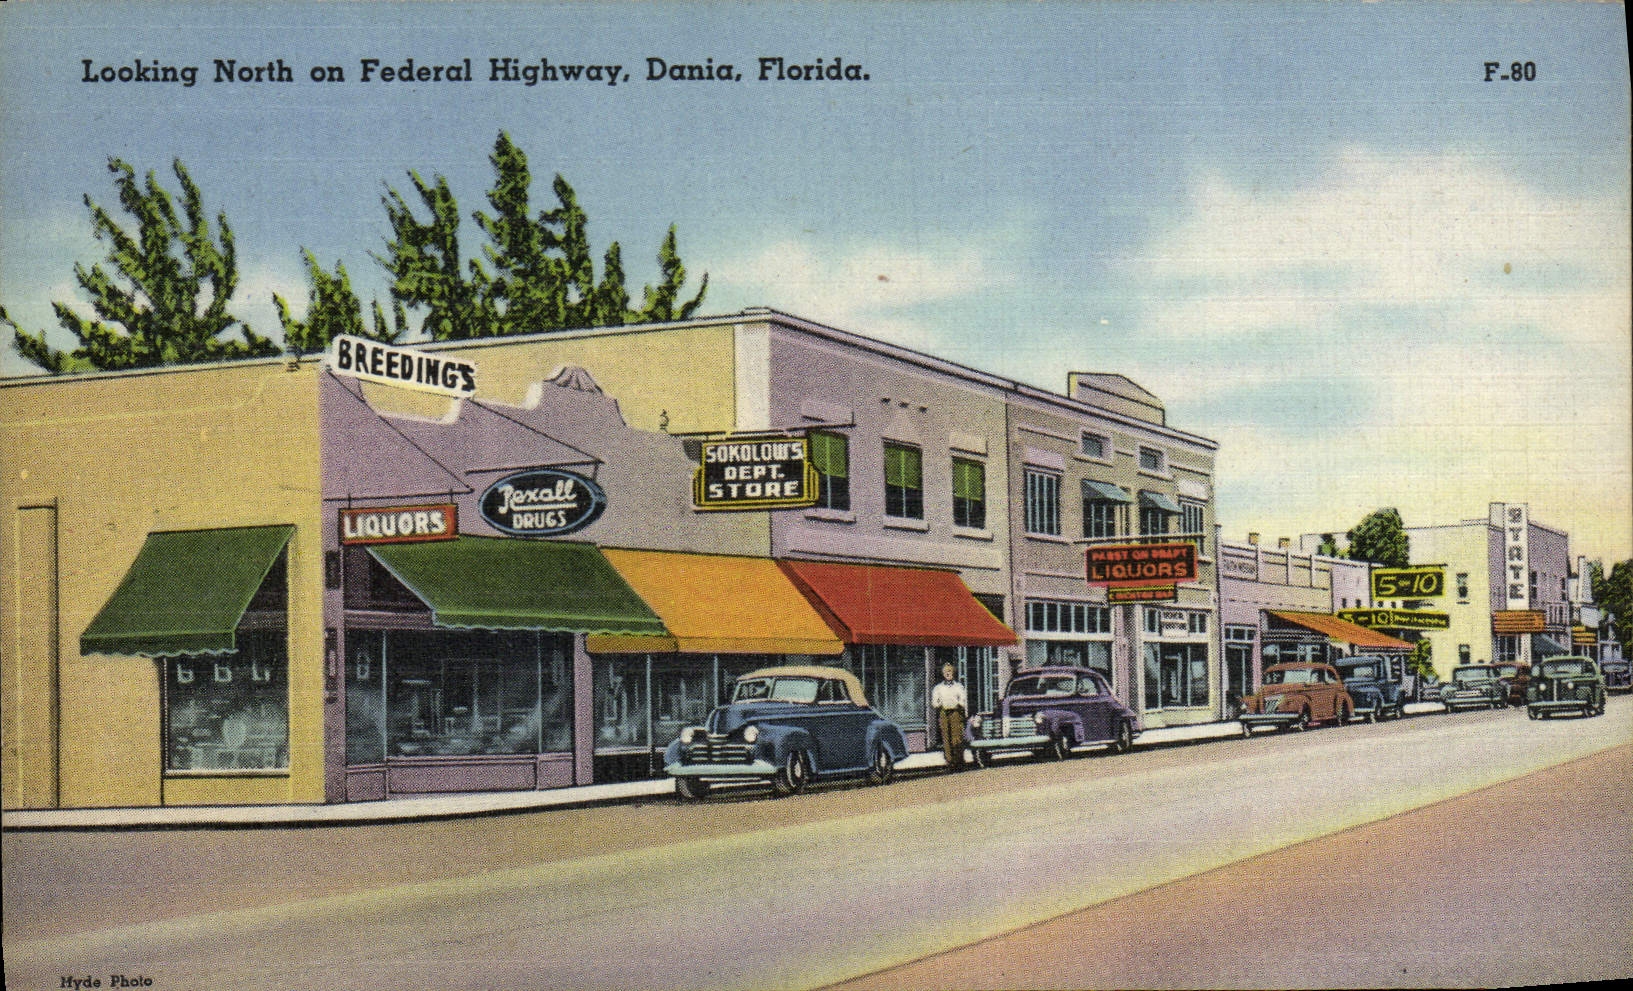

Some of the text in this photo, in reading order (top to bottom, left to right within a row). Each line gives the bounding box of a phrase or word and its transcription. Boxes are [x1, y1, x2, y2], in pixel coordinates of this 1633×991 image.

[724, 464, 785, 480] DEPT.
[498, 479, 577, 514] Rexall
[708, 480, 799, 498] STORE
[343, 510, 447, 539] LIQUORS
[512, 510, 567, 530] DRUGS
[1091, 561, 1188, 580] LIQUORS
[1379, 573, 1438, 596] 5-10
